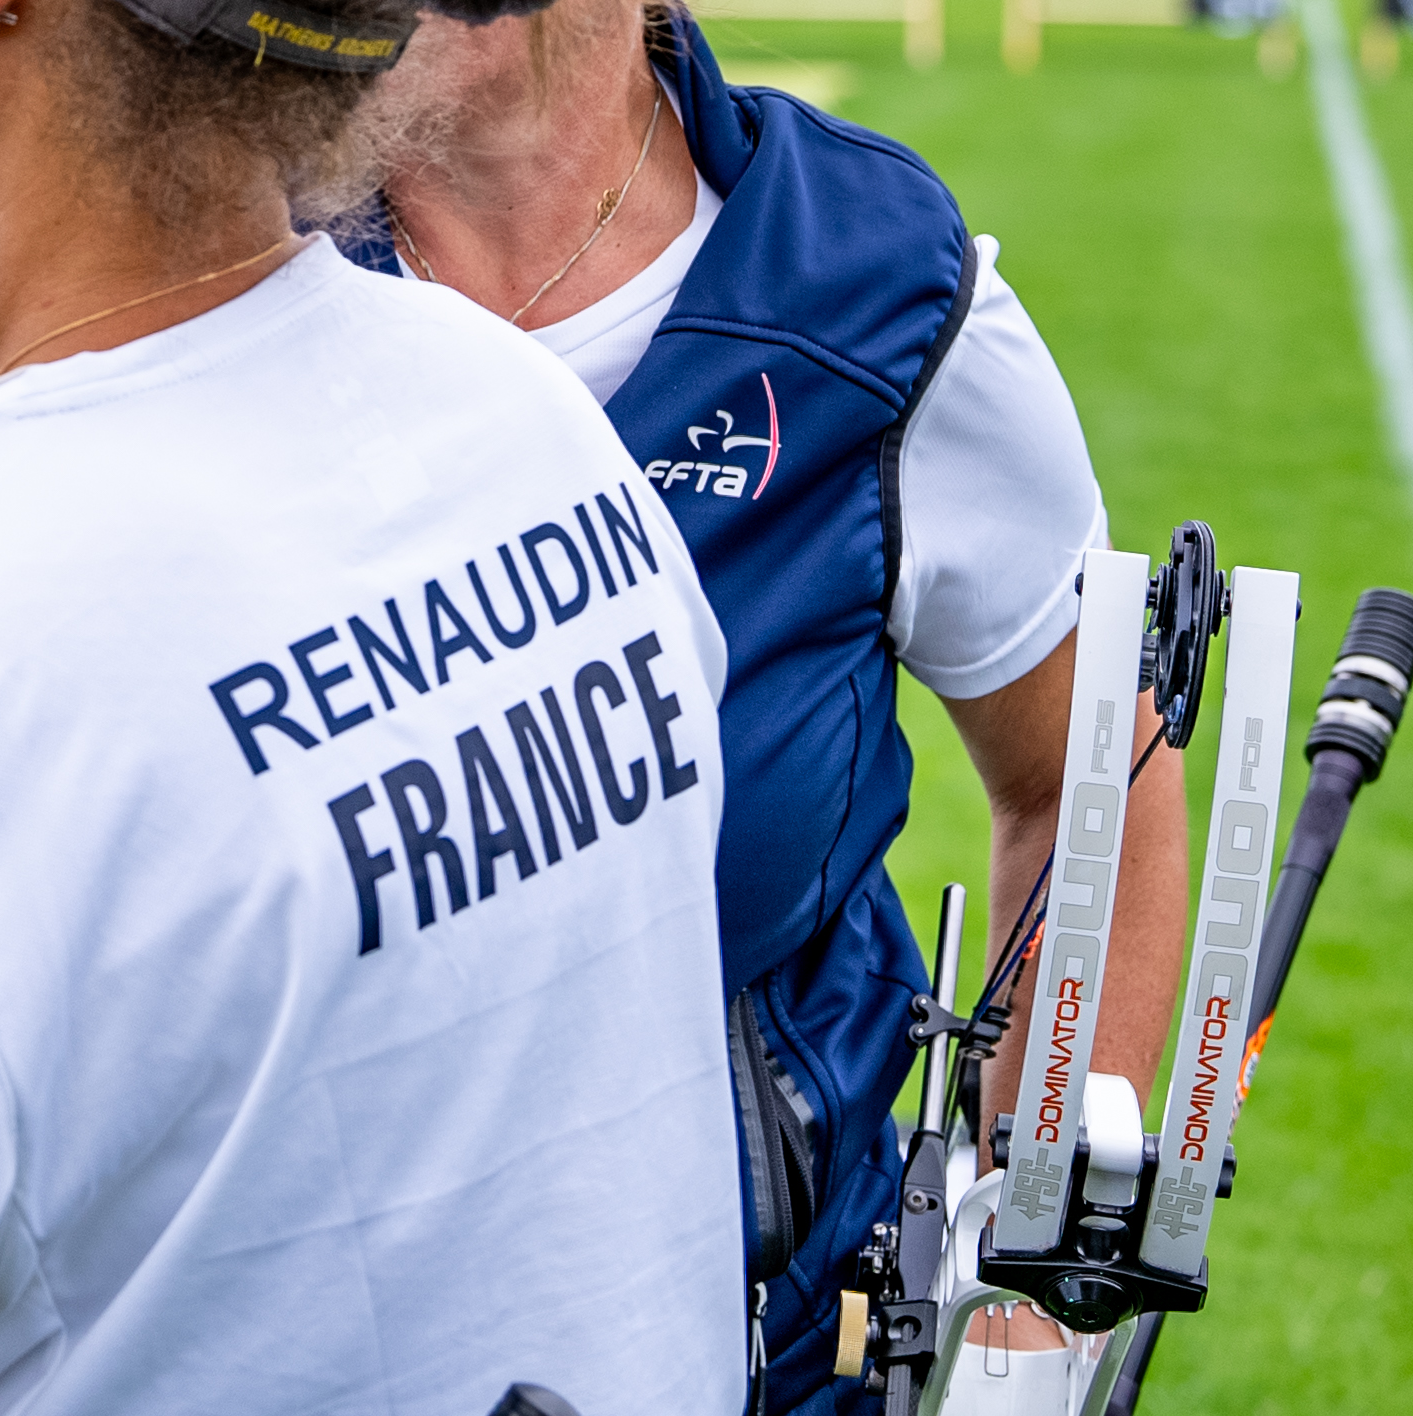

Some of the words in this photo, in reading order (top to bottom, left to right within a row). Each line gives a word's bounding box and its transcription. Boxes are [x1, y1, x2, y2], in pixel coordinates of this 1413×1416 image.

[208, 480, 660, 777] RENAUDIN
[326, 630, 699, 958] FRANCE
[1090, 698, 1116, 775] FDS
[1238, 716, 1264, 792] FDS
[1046, 781, 1120, 1003] DUO
[1193, 799, 1269, 1021] DUO
[1034, 976, 1084, 1144] DOMINATOR
[1179, 995, 1232, 1162] DOMINATOR
